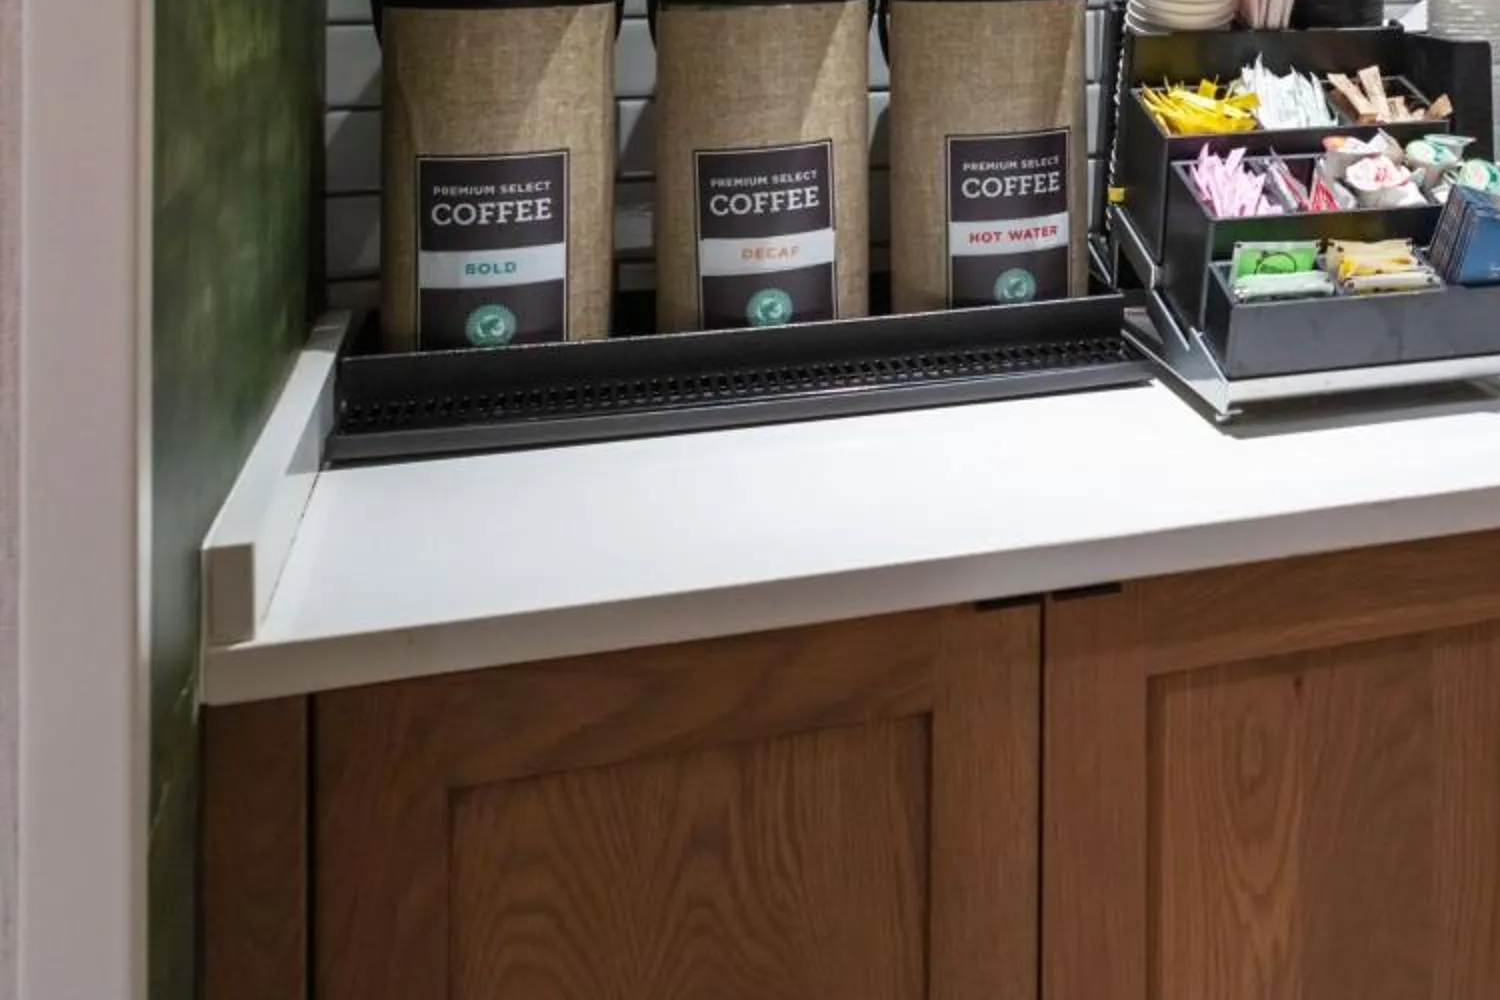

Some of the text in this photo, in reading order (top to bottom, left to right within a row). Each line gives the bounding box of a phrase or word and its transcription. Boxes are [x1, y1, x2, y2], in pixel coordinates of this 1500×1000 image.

[963, 155, 1060, 171] PREMIUM SELECT
[710, 169, 818, 188] PREMIUM SELECT
[961, 171, 1060, 199] COFFEE
[433, 181, 552, 196] PREMIUM SELECT
[709, 186, 820, 217] COFFEE
[431, 197, 552, 226] COFFEE
[969, 225, 1059, 244] HOT WATER
[740, 245, 800, 260] DECAF
[465, 261, 517, 275] BOLD
